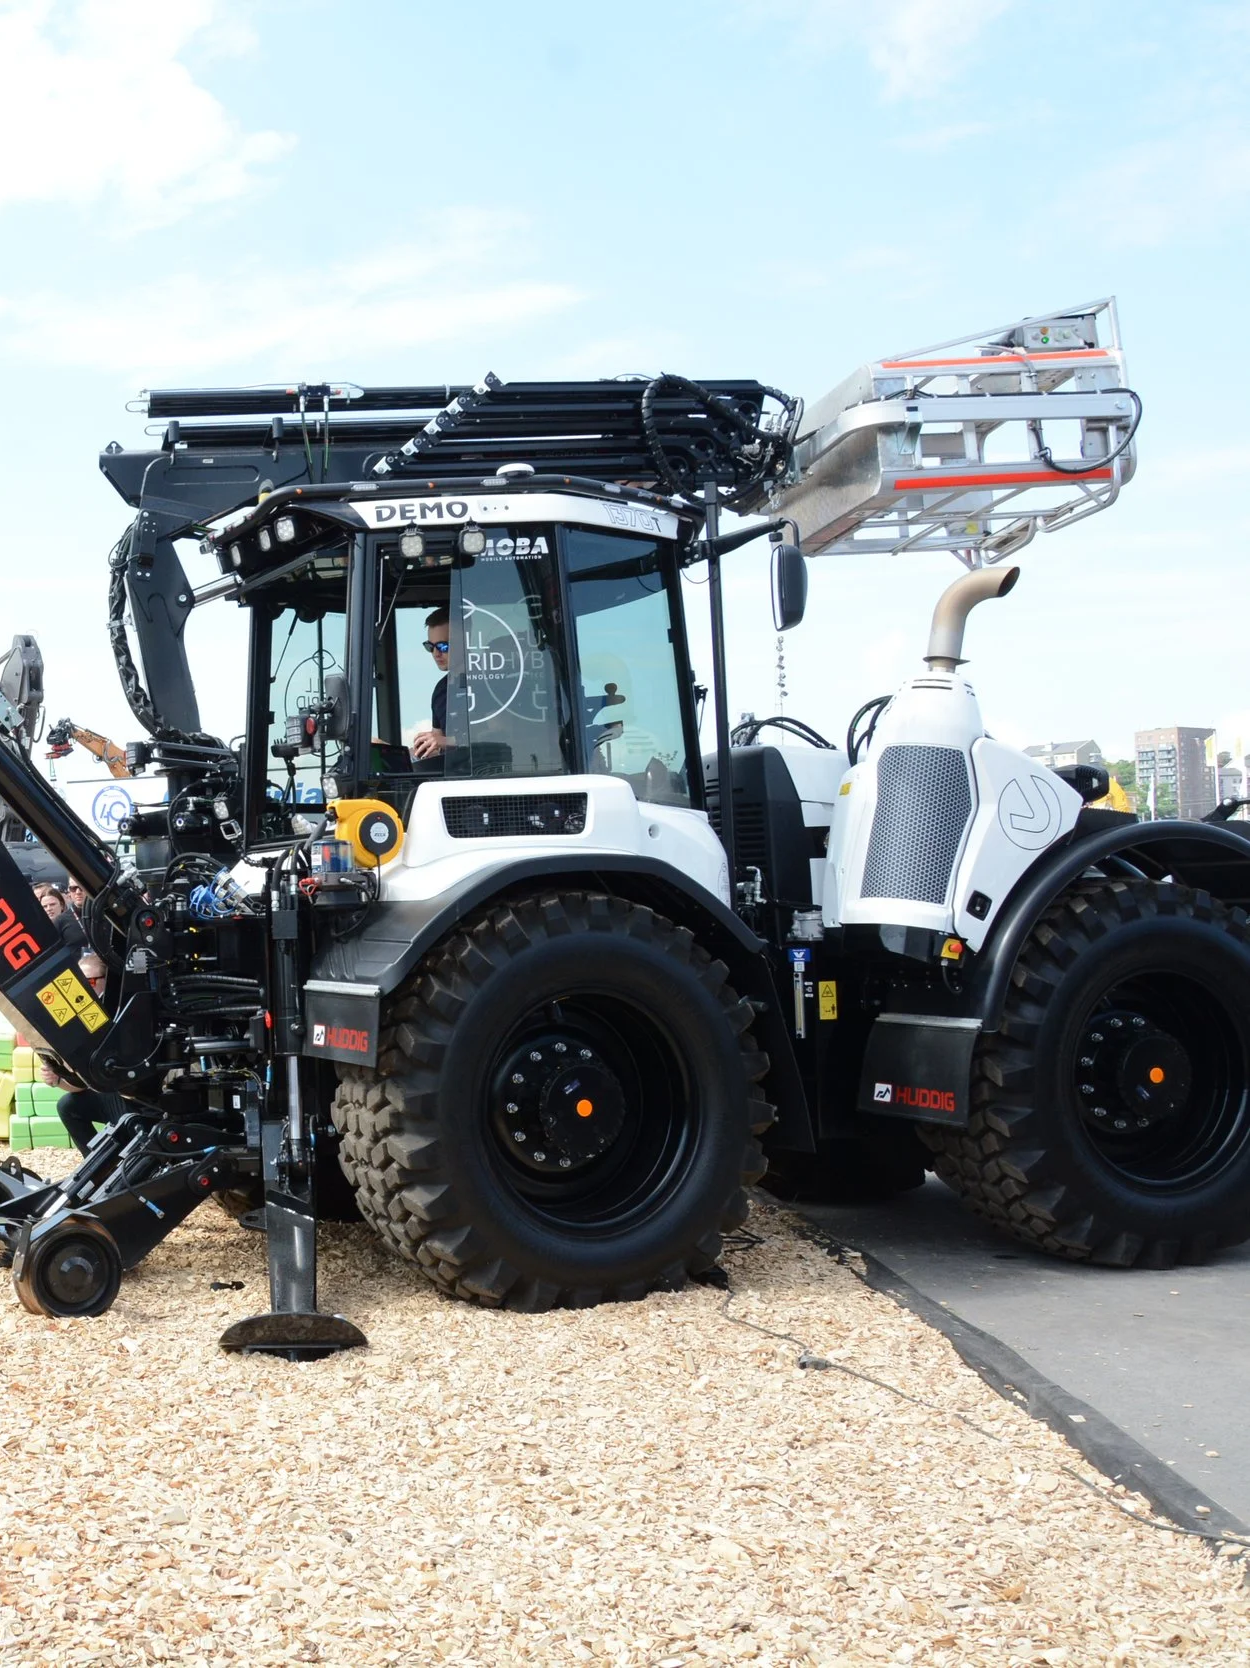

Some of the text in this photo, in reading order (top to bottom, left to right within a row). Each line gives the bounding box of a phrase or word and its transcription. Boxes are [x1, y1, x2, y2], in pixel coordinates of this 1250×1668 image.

[375, 501, 468, 522] DEMO
[326, 1026, 369, 1053] HUDDIG
[895, 1086, 956, 1112] HUDDIG
